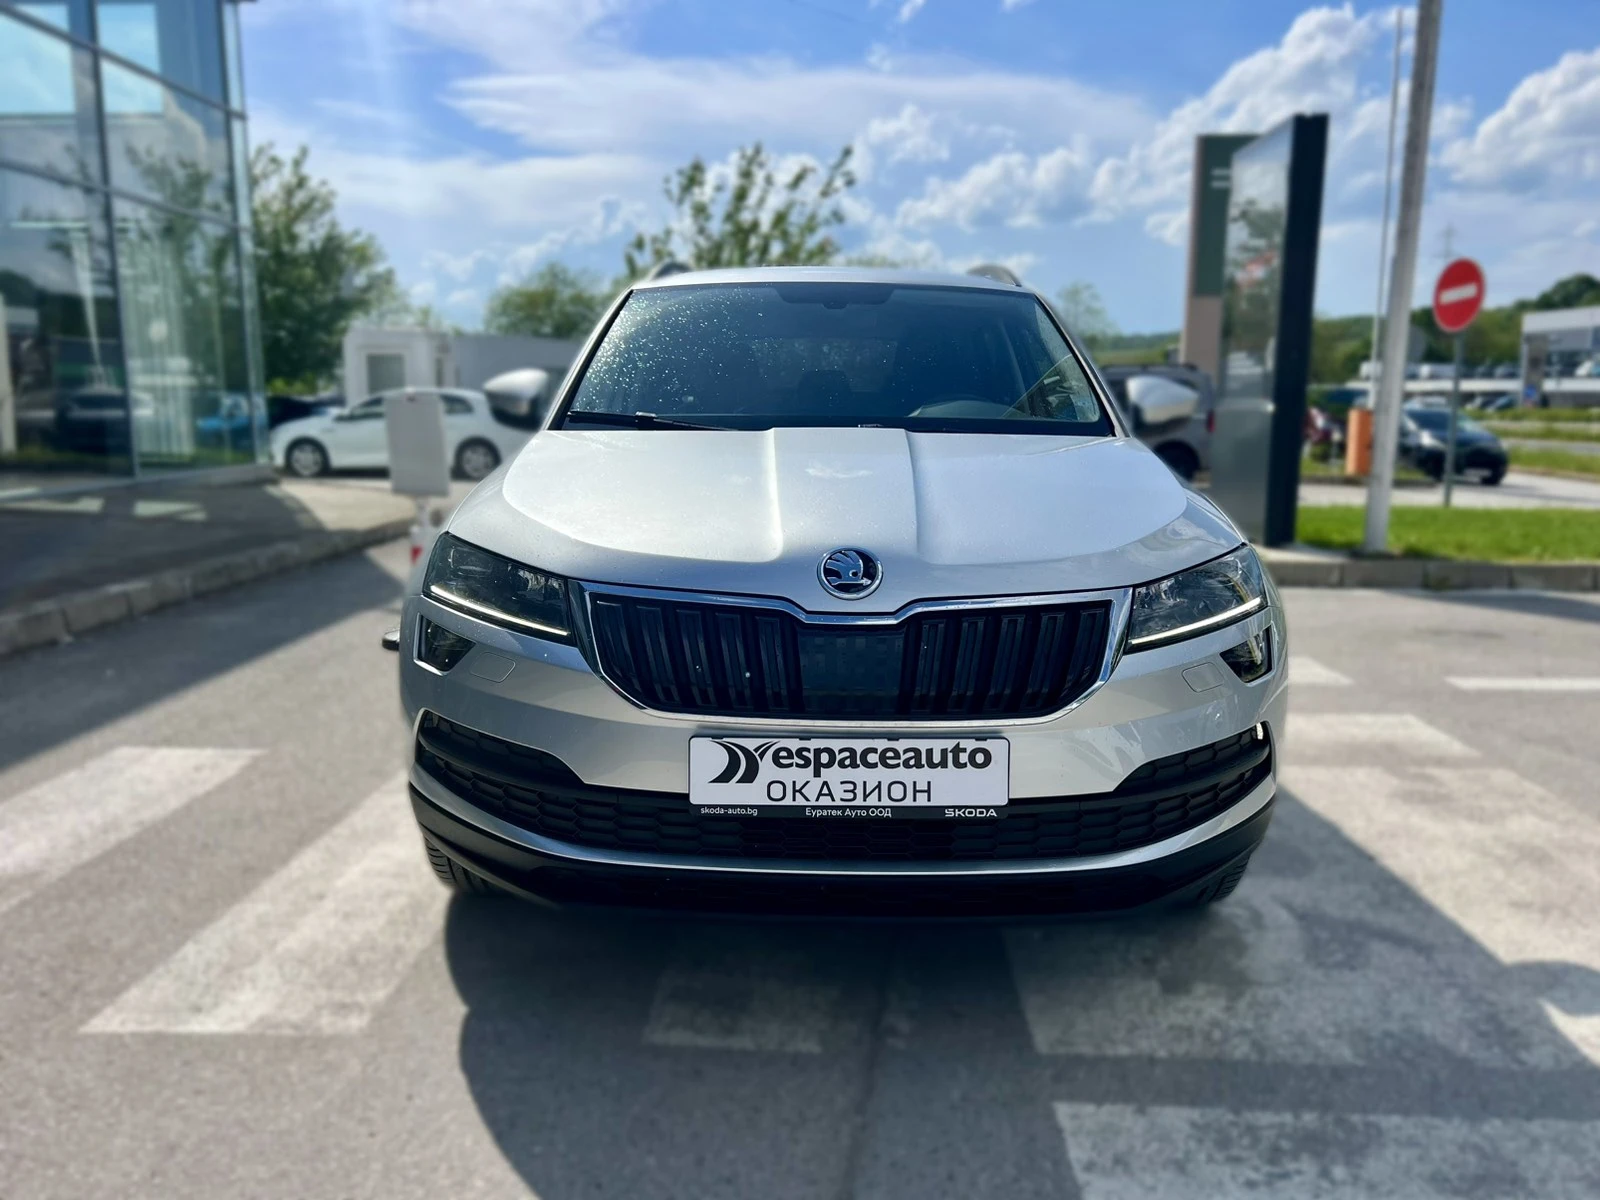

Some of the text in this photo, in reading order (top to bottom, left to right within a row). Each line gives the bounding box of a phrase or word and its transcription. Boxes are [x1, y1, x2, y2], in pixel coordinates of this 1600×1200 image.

[771, 741, 992, 777] espaceauto
[766, 780, 932, 802] ОКАЗИОН
[700, 806, 759, 816] skoda-auto.bg
[805, 807, 892, 817] Еуратек Ауто ООД
[944, 808, 997, 817] SKODA
